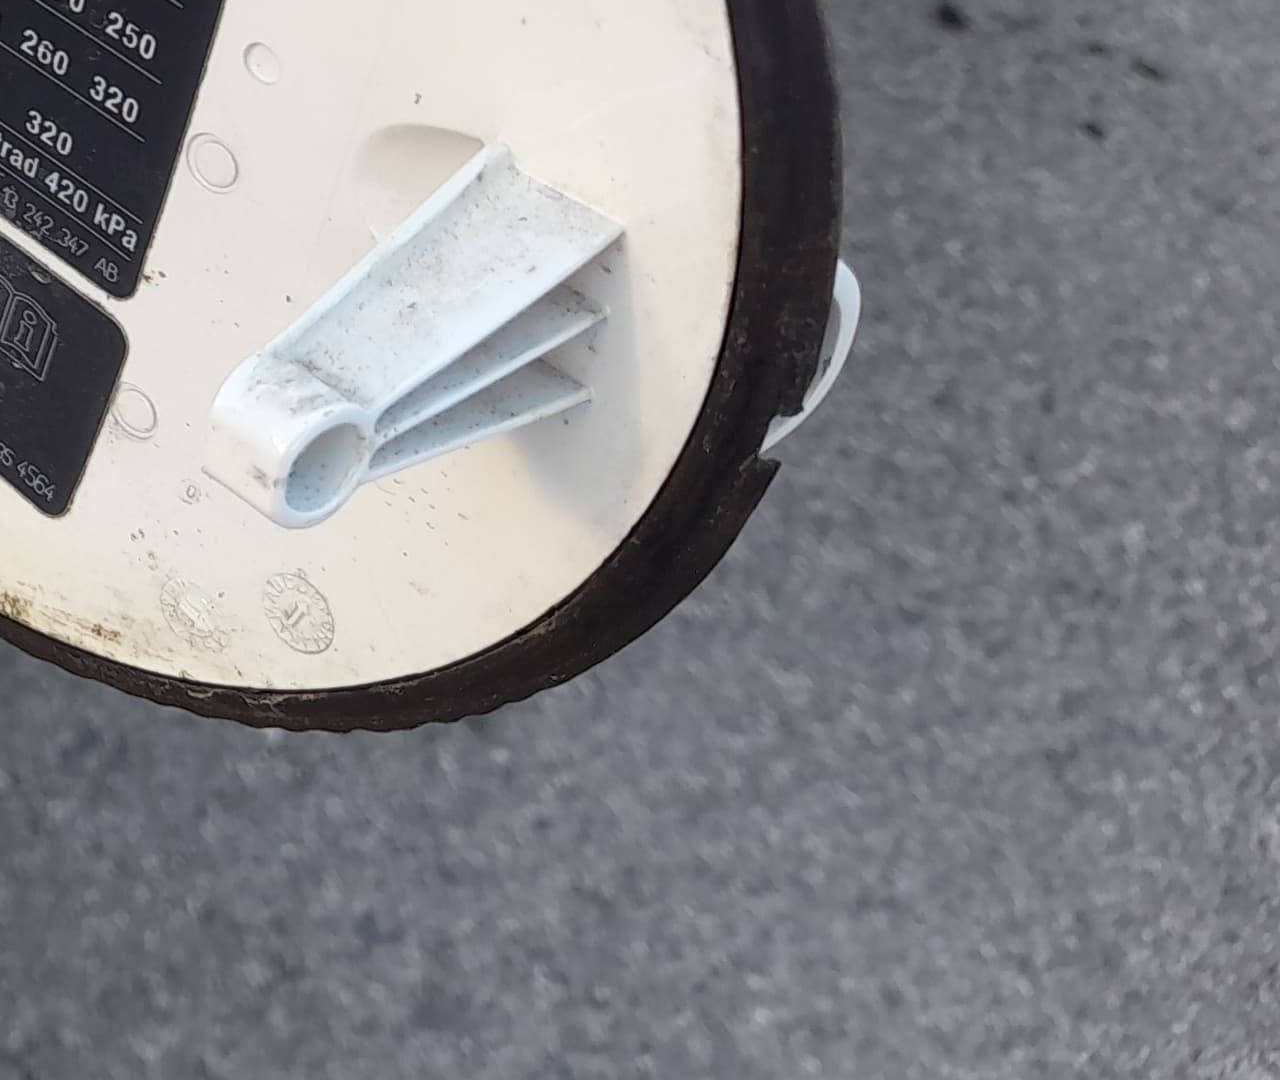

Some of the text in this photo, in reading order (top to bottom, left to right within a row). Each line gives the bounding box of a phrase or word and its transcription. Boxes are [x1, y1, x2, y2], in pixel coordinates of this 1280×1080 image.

[105, 12, 156, 60] 250
[20, 29, 69, 75] 260
[89, 75, 139, 123] 320
[25, 110, 73, 155] 320
[44, 172, 88, 213] 420
[93, 203, 137, 252] kPa
[95, 258, 119, 283] AB
